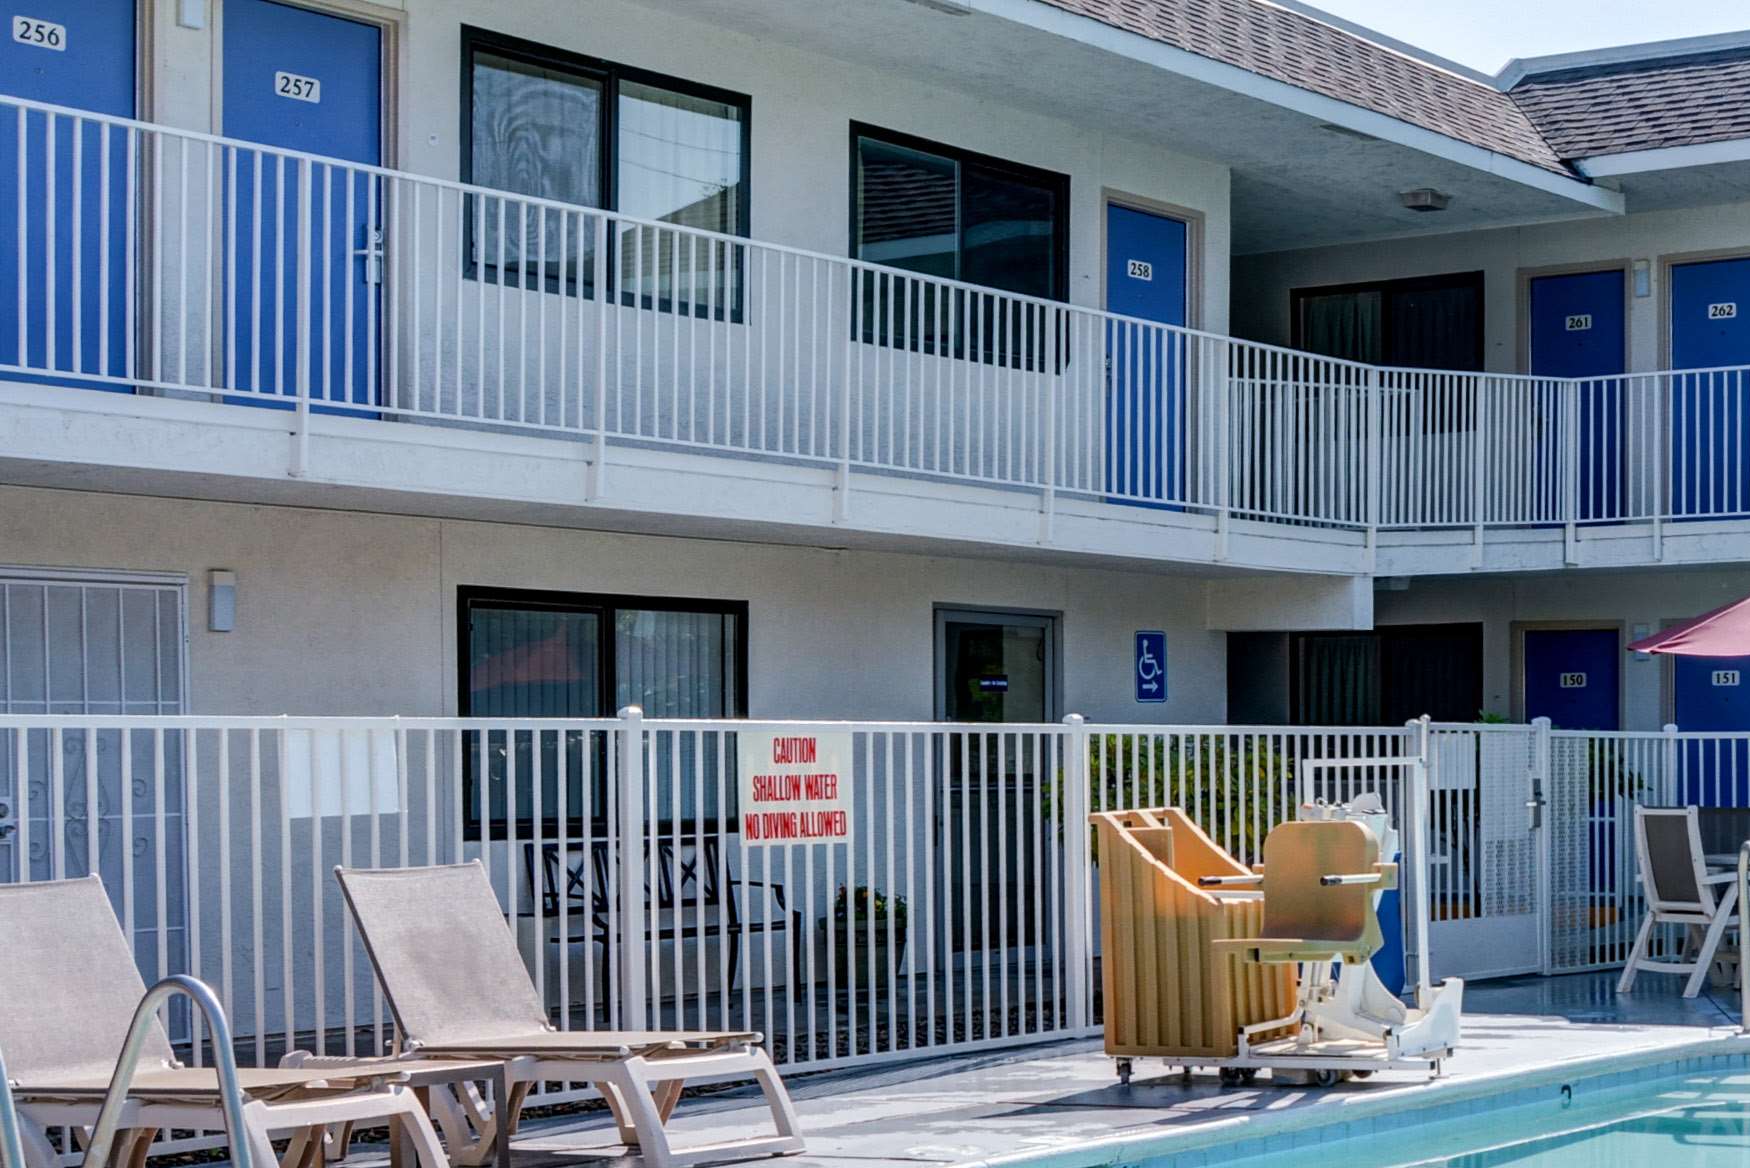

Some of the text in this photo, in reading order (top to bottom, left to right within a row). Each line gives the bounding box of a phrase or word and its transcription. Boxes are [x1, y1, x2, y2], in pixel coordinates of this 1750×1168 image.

[19, 20, 60, 46] 256
[280, 75, 315, 98] 257
[1130, 262, 1150, 278] 258
[1711, 304, 1734, 317] 262
[1568, 317, 1589, 329] 261
[1562, 674, 1584, 686] 150
[1715, 672, 1737, 684] 151
[773, 736, 817, 764] CAUTION
[752, 773, 838, 802] SHALLOW WATER
[745, 810, 847, 840] NO DIVING ALLOWED
